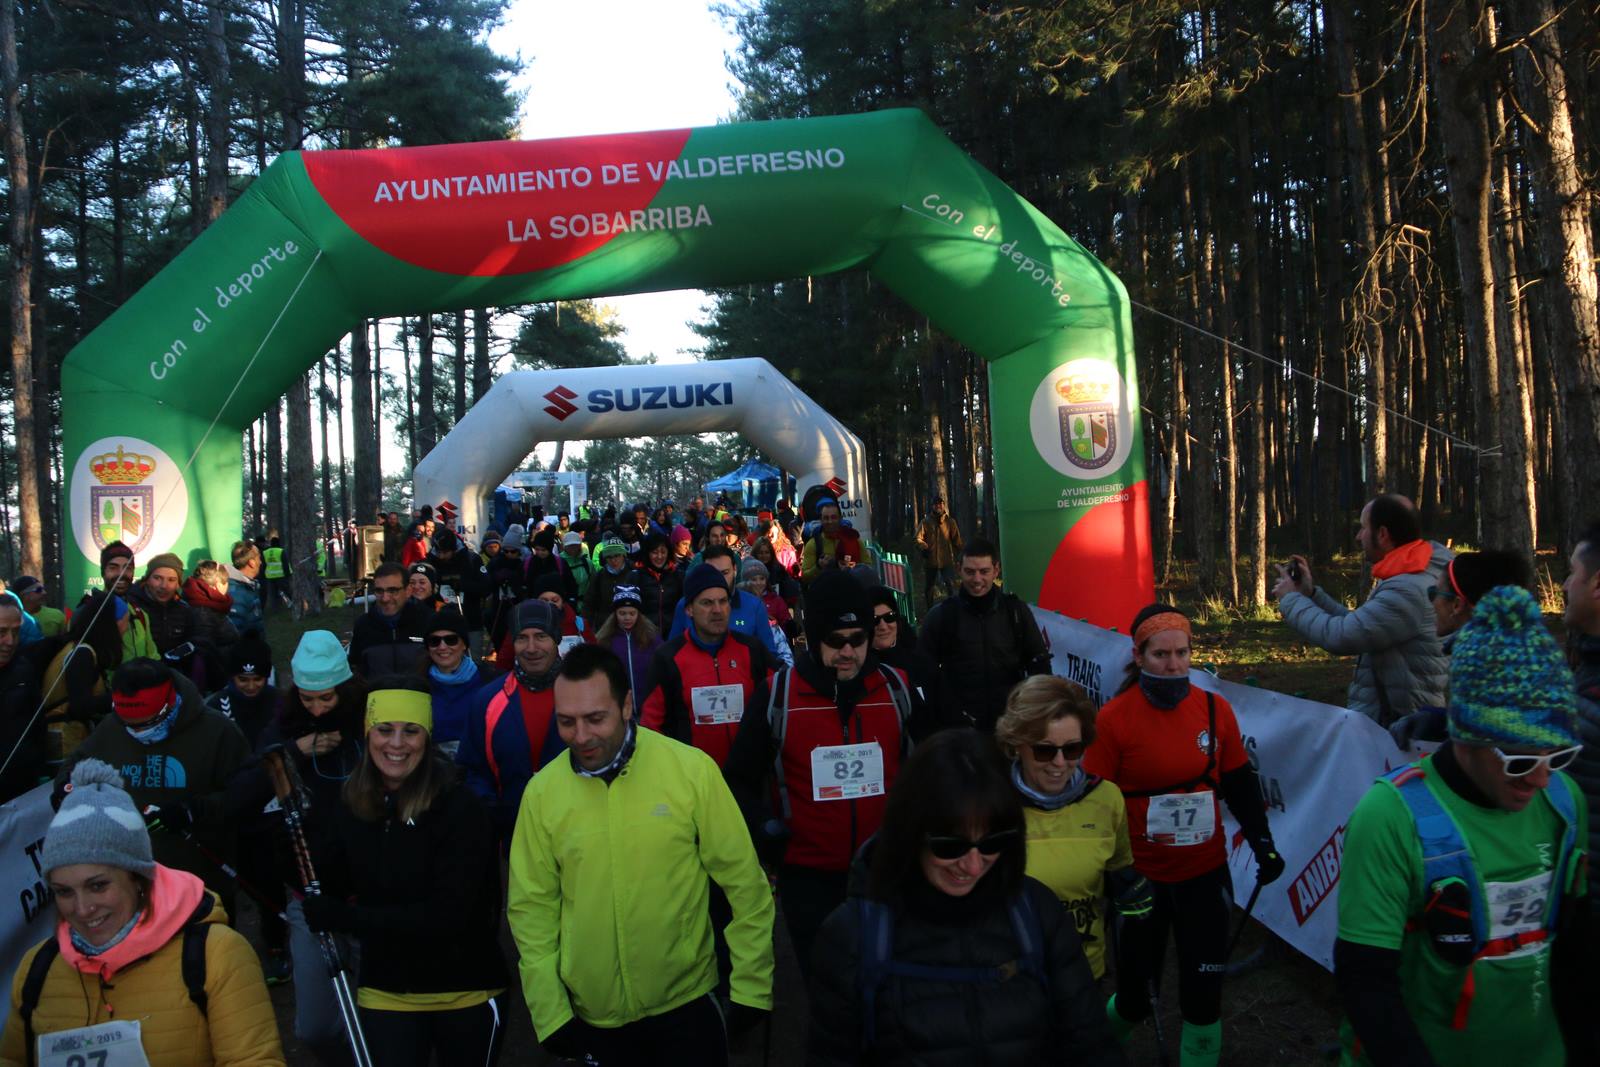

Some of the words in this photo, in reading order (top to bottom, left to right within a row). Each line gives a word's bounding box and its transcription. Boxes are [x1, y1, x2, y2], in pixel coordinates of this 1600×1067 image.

[374, 166, 593, 204] AYUNTAMIENTO
[601, 163, 641, 185] DE
[647, 148, 846, 182] VALDEFRESNO
[507, 218, 541, 242] LA
[550, 204, 713, 240] SOBARRIBA
[921, 193, 965, 224] Con
[972, 224, 997, 241] el
[999, 239, 1072, 308] deporte
[149, 338, 188, 381] Con
[192, 306, 213, 333] el
[215, 240, 299, 309] deporte
[586, 381, 734, 414] SUZUKI
[1057, 499, 1070, 509] DE
[1071, 493, 1130, 507] VALDEFRESNO
[1061, 482, 1125, 497] AYUNTAMIENTO
[1066, 652, 1102, 690] TRANS
[707, 696, 728, 711] 71
[833, 759, 865, 780] 82
[1170, 808, 1198, 828] 17
[1501, 897, 1544, 927] 52
